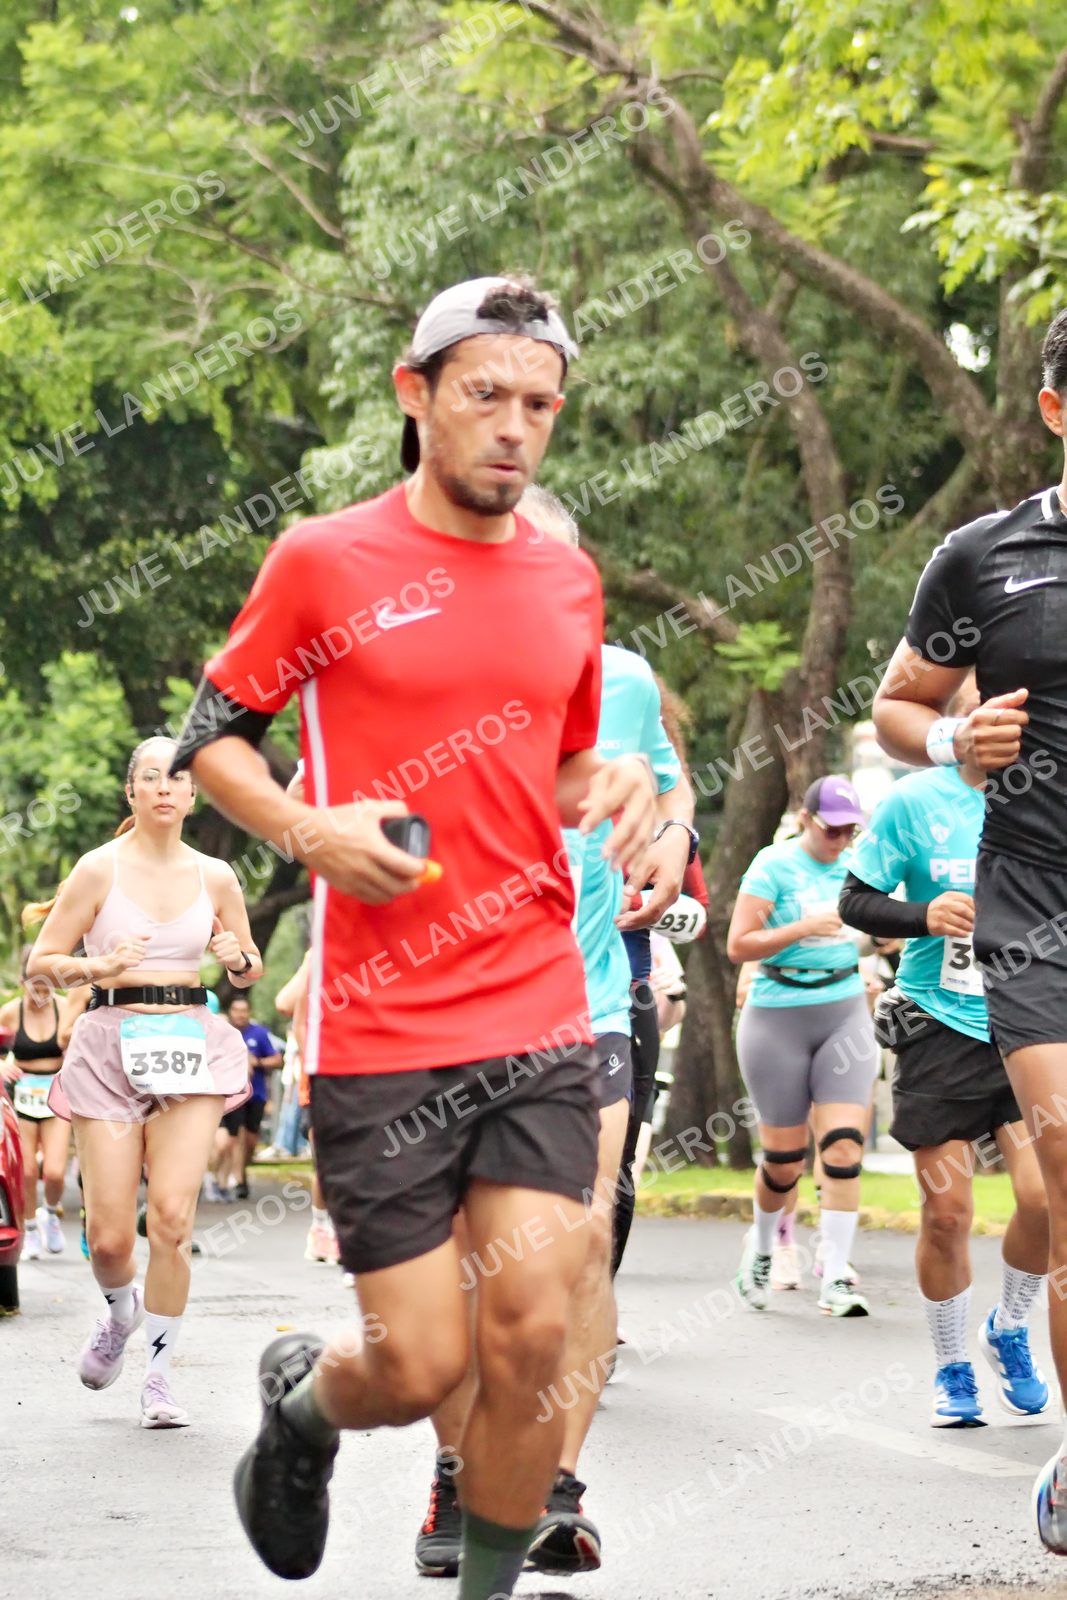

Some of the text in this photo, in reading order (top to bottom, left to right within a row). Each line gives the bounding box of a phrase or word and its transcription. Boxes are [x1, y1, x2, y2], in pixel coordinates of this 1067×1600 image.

[650, 912, 699, 933] 931
[948, 942, 974, 970] 3
[130, 1050, 202, 1076] 3387
